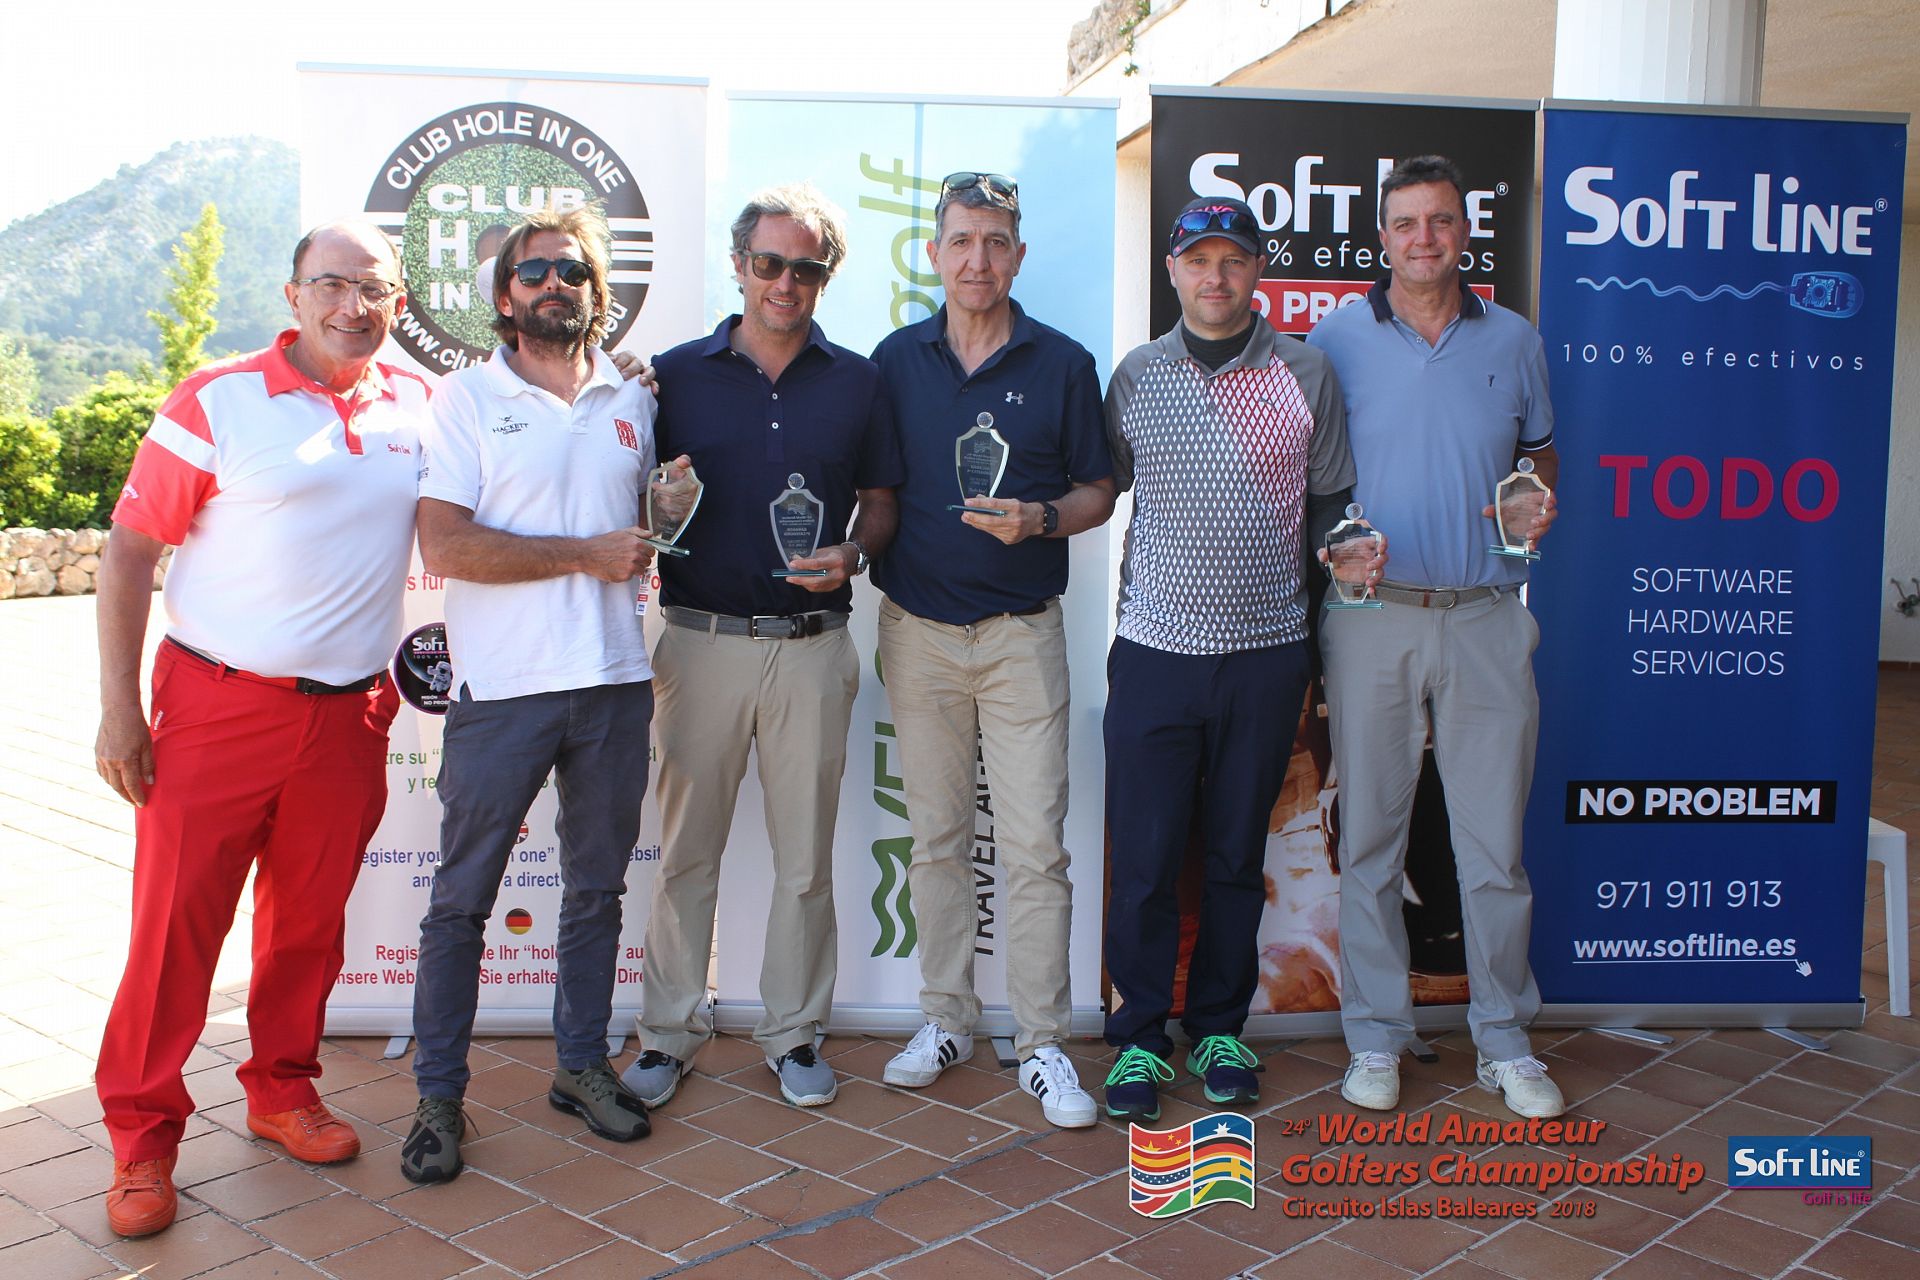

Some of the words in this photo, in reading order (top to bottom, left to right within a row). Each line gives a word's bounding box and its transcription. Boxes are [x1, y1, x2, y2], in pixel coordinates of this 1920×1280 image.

[386, 127, 452, 189] CLUB
[453, 110, 534, 142] HOLE
[539, 117, 571, 149] IN
[571, 137, 626, 193] ONE
[427, 184, 586, 214] CLUB
[429, 282, 470, 311] IN
[1564, 343, 1653, 365] 100%
[1682, 348, 1864, 371] efectivos
[491, 422, 529, 433] HACKETT
[1599, 455, 1840, 522] TODO
[1632, 567, 1794, 594] SOFTWARE
[1628, 609, 1794, 635] HARDWARE
[1631, 650, 1785, 676] SERVICIOS
[409, 752, 427, 765] su
[408, 777, 416, 793] y
[1578, 787, 1635, 816] NO
[1644, 787, 1822, 816] PROBLEM
[362, 848, 413, 868] egister
[504, 875, 512, 887] a
[517, 872, 560, 887] direct
[1597, 880, 1651, 909] 971
[1666, 880, 1712, 908] 911
[1727, 880, 1782, 908] 913
[500, 945, 519, 960] Ihr
[1573, 933, 1797, 959] www.softline.es
[337, 972, 378, 985] nsere
[480, 969, 503, 985] Sie
